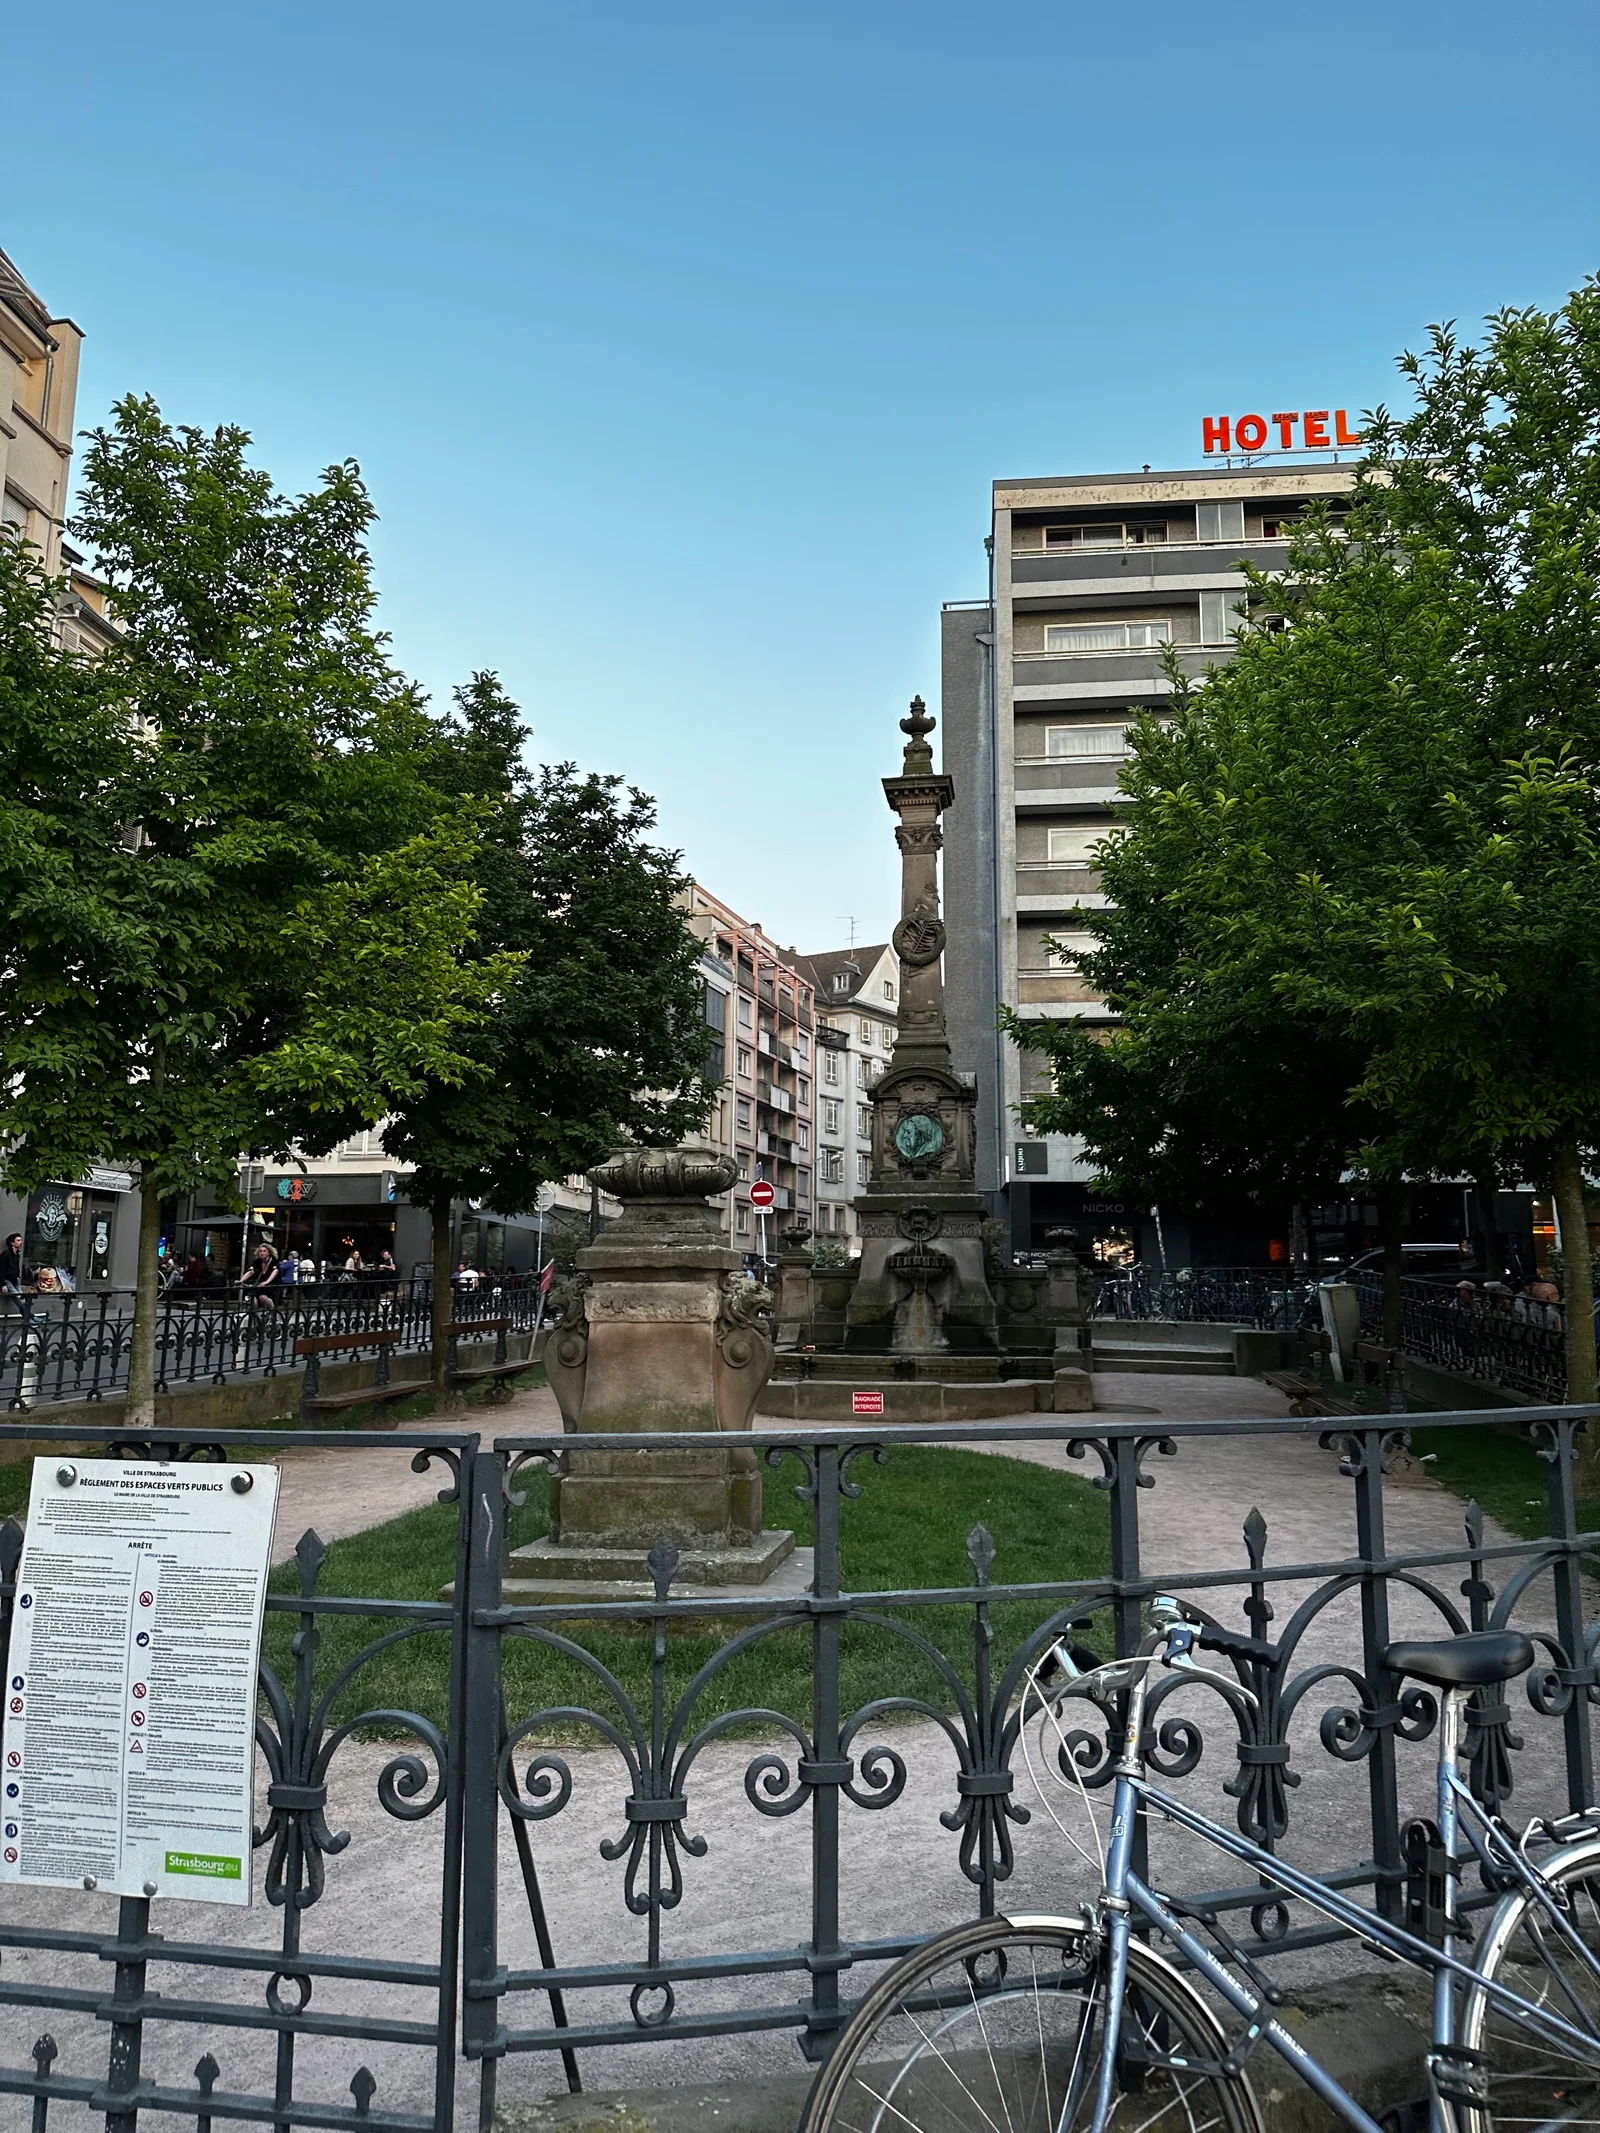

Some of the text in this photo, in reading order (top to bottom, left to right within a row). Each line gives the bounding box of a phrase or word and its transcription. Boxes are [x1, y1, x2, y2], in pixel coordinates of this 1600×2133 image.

[1203, 409, 1363, 452] HOTEL
[1082, 1204, 1125, 1213] NICKO
[79, 1478, 224, 1491] RÈGLEMENT DES ESPACES VERTS PUBLICS
[128, 1541, 153, 1550] ARRÊTE
